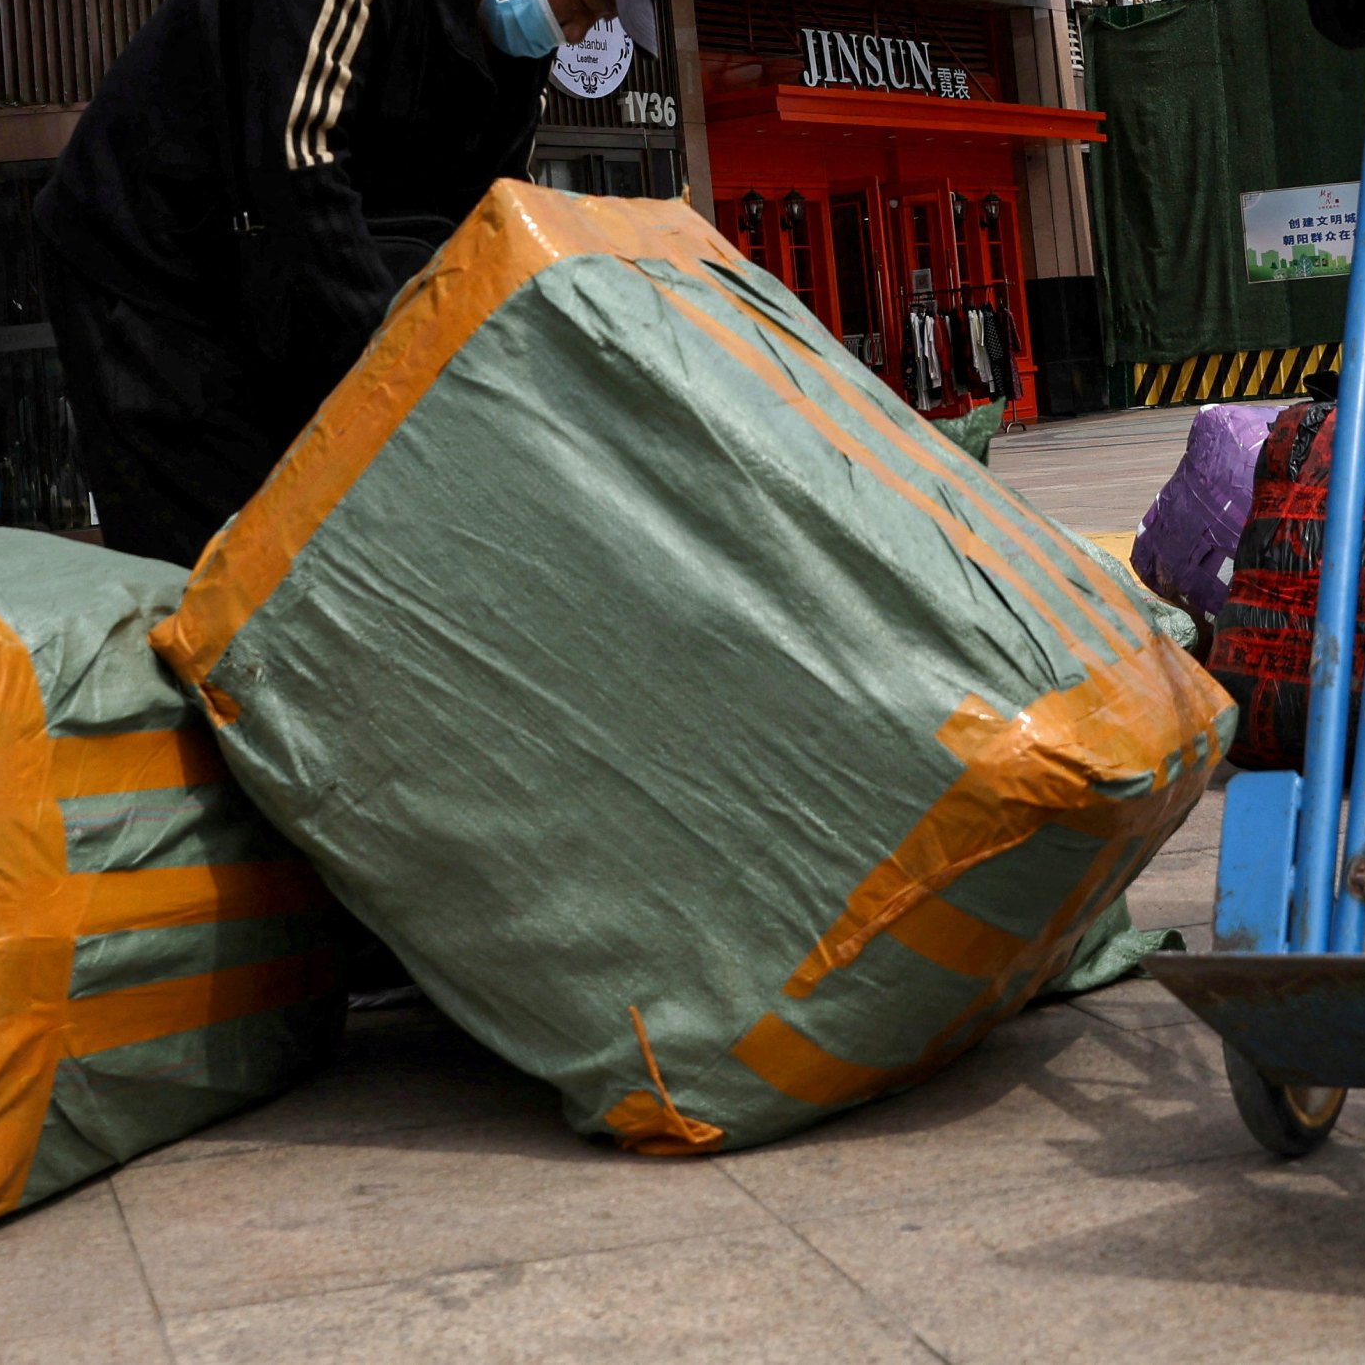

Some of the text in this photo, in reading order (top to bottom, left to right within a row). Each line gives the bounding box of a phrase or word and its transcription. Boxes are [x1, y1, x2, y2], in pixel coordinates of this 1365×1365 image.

[577, 54, 599, 63] Leather
[799, 28, 936, 94] JINSUN
[625, 91, 676, 126] 1Y36
[1288, 212, 1357, 230] 创建文明城
